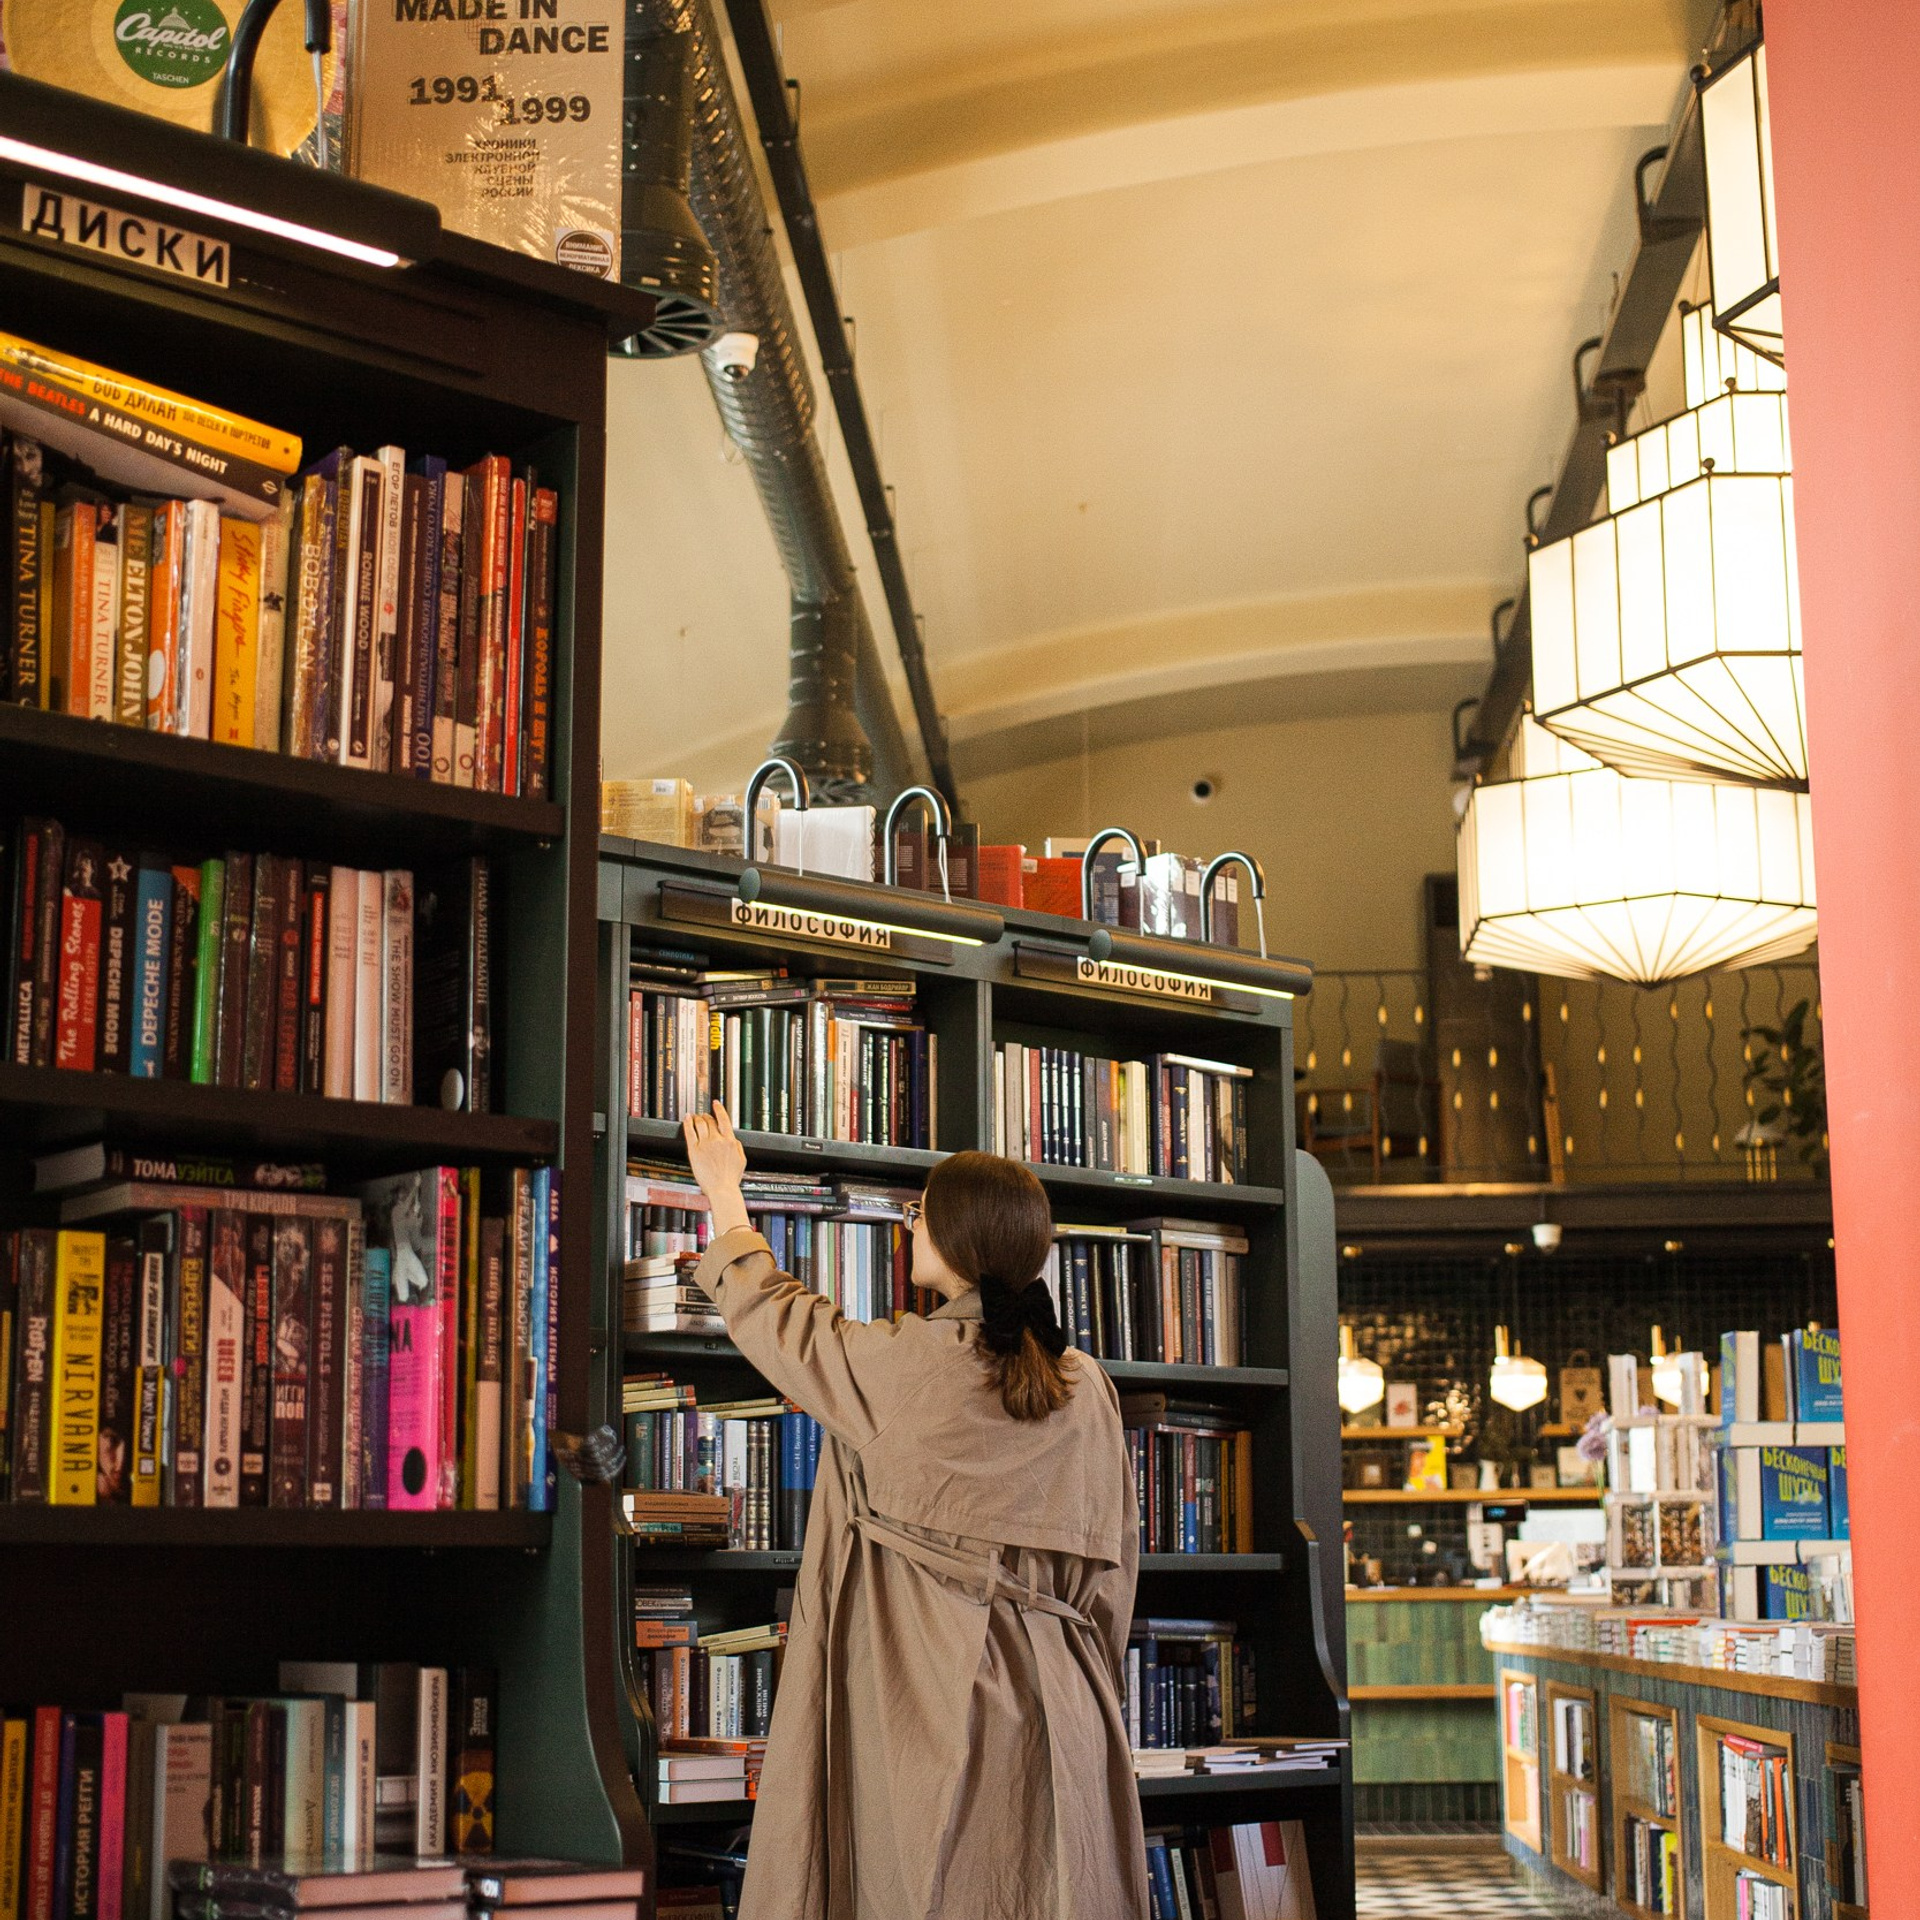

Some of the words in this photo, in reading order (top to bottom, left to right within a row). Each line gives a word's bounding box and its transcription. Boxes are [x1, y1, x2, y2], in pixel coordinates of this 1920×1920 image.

[116, 12, 227, 50] Capitol
[395, 0, 507, 21] MADE
[519, 0, 557, 19] IN
[135, 46, 211, 63] RECORDS
[479, 25, 609, 55] DANCE
[152, 72, 189, 84] TASCHEN
[409, 74, 503, 105] 1991
[499, 94, 591, 126] 1999
[31, 191, 225, 283] ДИСКИ
[27, 380, 86, 415] BEATLES
[88, 407, 101, 422] A
[104, 413, 142, 439] HARD
[145, 430, 183, 456] DAY'S
[186, 448, 229, 475] NIGHT
[124, 391, 178, 422] ДИЛАН
[390, 461, 401, 490] ЕГОР
[427, 479, 438, 512] РОКА
[389, 491, 400, 528] ЛЕТОВ
[19, 526, 35, 581] TINA
[231, 530, 257, 583] Sticky
[303, 543, 320, 590] BOB
[360, 550, 373, 602] RONNIE
[423, 514, 437, 597] СОВЕТСКОГО
[97, 579, 111, 623] TINA
[125, 558, 145, 644] ELTON
[221, 586, 249, 657] Fingers
[357, 604, 371, 651] WOOD
[18, 588, 35, 686] TURNER
[300, 596, 316, 671] DYLAN
[95, 631, 110, 705] TURNER
[121, 645, 143, 721] JOHN
[417, 599, 432, 729] МАГНИТОАЛЬБОМОВ
[534, 627, 549, 696] КОРОЛЬ
[415, 732, 431, 770] 100
[66, 901, 86, 955] Stones
[145, 898, 164, 957] MODE
[391, 938, 401, 961] THE
[736, 904, 887, 946] ФИЛОСОФИЯ
[107, 926, 124, 1000] DEPECHE
[391, 966, 401, 1003] SHOW
[1081, 960, 1208, 998] ФИЛОСОФИЯ
[62, 961, 85, 1021] Rolling
[141, 959, 160, 1046] DEPECHE
[16, 981, 33, 1065] METALLICA
[60, 1028, 78, 1060] The
[104, 1003, 120, 1054] MODE
[391, 1007, 400, 1042] MUST
[390, 1045, 400, 1065] GO
[390, 1068, 401, 1088] ON
[133, 1159, 177, 1179] ТОМА
[178, 1162, 235, 1185] УЭЙТСА
[518, 1184, 529, 1251] ФРЕДДИ
[321, 1262, 334, 1296] SEX
[484, 1256, 500, 1312] Айлиш
[517, 1256, 528, 1348] МЕРКЬЮРИ
[548, 1266, 558, 1322] ИСТОРИЯ
[320, 1302, 332, 1375] PISTOLS
[1067, 1297, 1075, 1329] ЛОГОСУ
[484, 1323, 500, 1366] Билли
[548, 1326, 558, 1382] ЛЕГЕНДЫ
[63, 1353, 96, 1472] NIRVANA
[430, 1675, 440, 1774] МЮЗИКМЕЙКЕРА
[77, 1768, 94, 1824] РЕГГИ
[429, 1780, 438, 1848] АКАДЕМИЯ
[74, 1828, 92, 1915] ИСТОРИЯ
